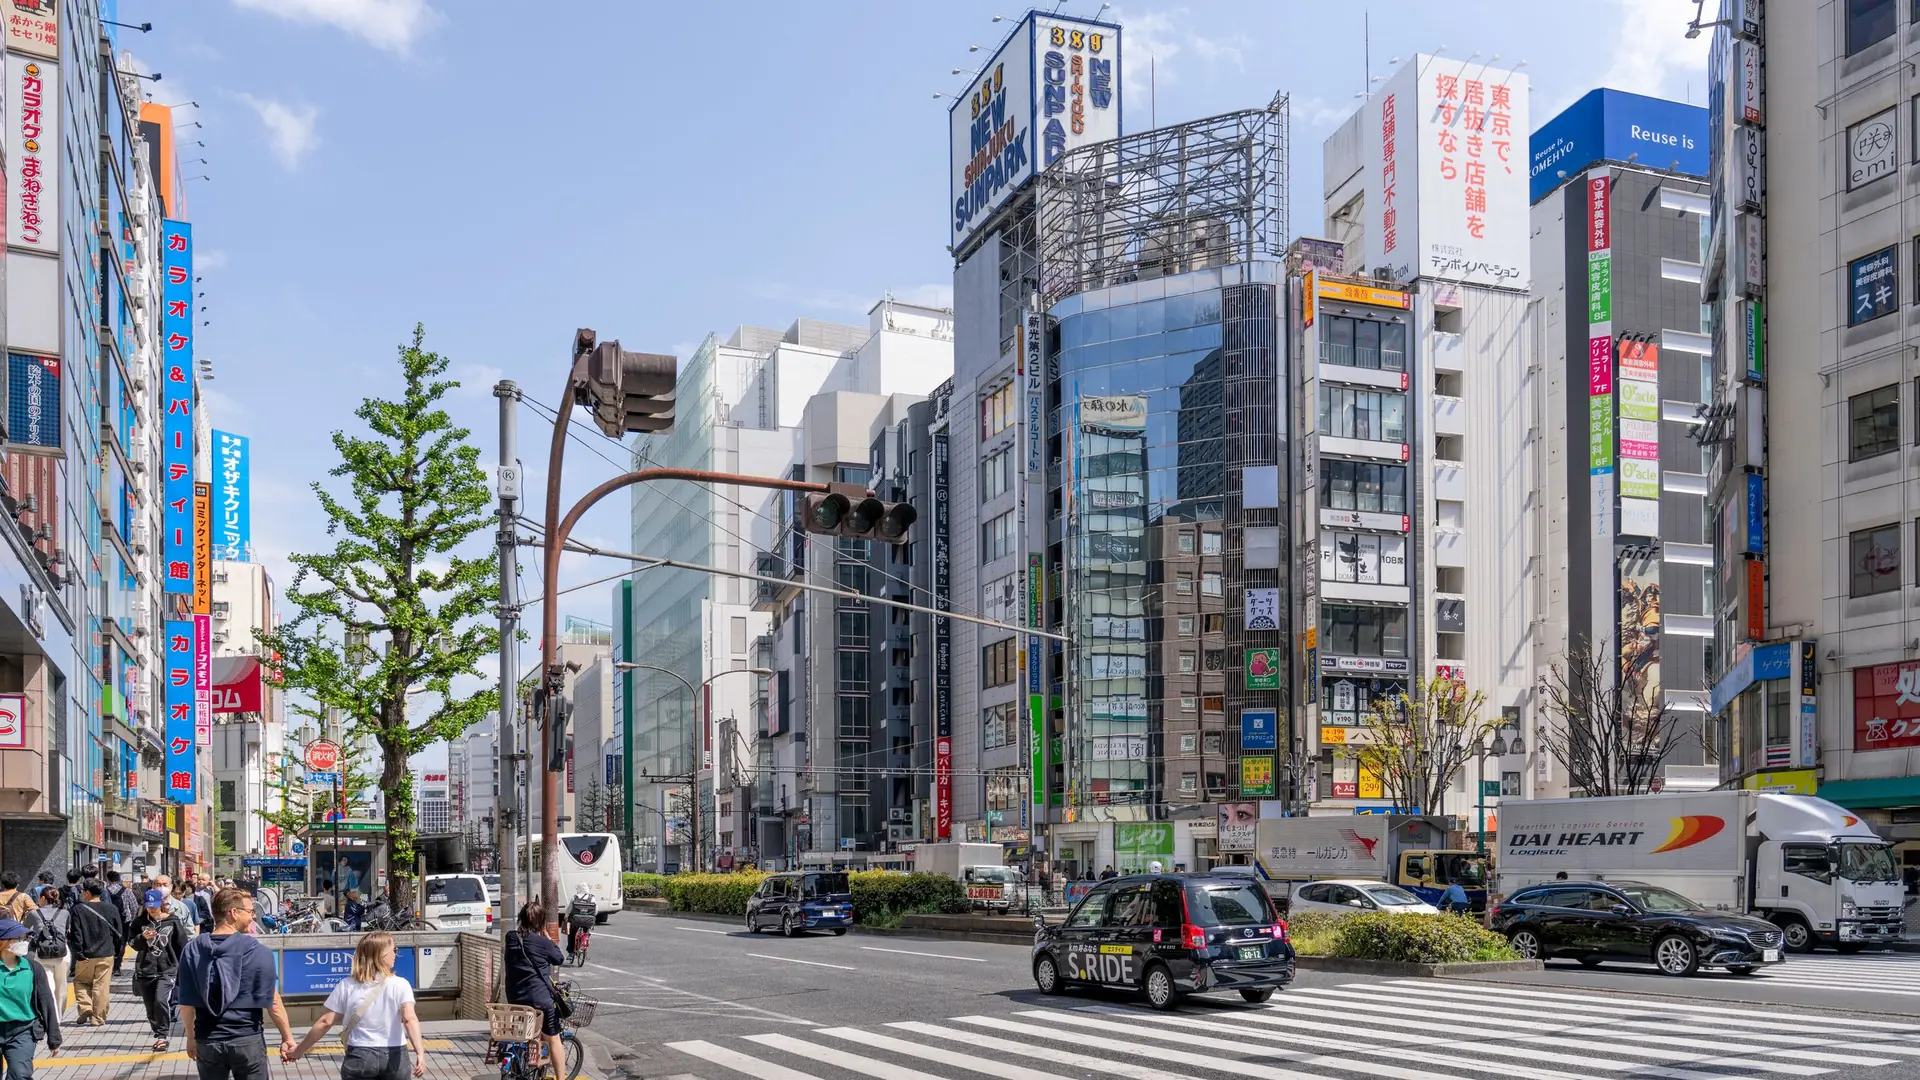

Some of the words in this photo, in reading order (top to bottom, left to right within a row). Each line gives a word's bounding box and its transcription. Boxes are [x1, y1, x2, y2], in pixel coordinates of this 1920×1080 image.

[9, 14, 56, 34] 赤から鍋
[10, 27, 57, 46] セセリ焼
[1745, 23, 1755, 34] 6F
[1050, 26, 1104, 53] 389
[1089, 57, 1112, 108] NEW
[1745, 47, 1754, 102] パムッカレ
[972, 62, 1004, 120] 389
[1071, 55, 1085, 134] SHINJUKU
[22, 75, 43, 139] カラオケ
[970, 87, 1007, 159] NEW
[1435, 73, 1458, 180] 探すなら
[1490, 84, 1512, 175] 東京で、
[1631, 125, 1678, 146] Reuse
[1682, 134, 1694, 149] is
[964, 115, 1015, 188] SHINJUKU
[1463, 79, 1486, 239] 居抜き店舗を
[1535, 143, 1556, 161] Reuse
[1556, 137, 1564, 147] is
[955, 126, 1028, 232] SUNPARK
[1382, 93, 1396, 255] 店舗専門不動産
[1747, 129, 1757, 201] MOUTON
[1852, 151, 1895, 183] emi
[20, 156, 43, 245] まねきねこ
[1594, 191, 1605, 249] 東京美容外科
[1431, 243, 1464, 256] 株式会社
[1431, 255, 1520, 279] テンポイノベーション
[1601, 261, 1610, 294] オラクル
[1855, 266, 1894, 288] 美容皮膚科
[1858, 256, 1889, 275] 美容外科
[1591, 262, 1601, 311] 美容皮膚科
[1856, 285, 1893, 314] スキ
[1594, 311, 1607, 320] 8F
[1592, 339, 1601, 383] クリニック
[1601, 338, 1609, 373] フィラー
[1402, 374, 1408, 388] 7F
[1594, 383, 1608, 393] 7F
[1622, 384, 1656, 403] Oracle
[167, 233, 190, 580] カラオケ&パーティー館
[1602, 396, 1612, 436] オラクル
[1030, 397, 1039, 458] パステルコート
[1591, 397, 1602, 456] 美容皮膚科
[1403, 444, 1408, 459] 6F
[1621, 442, 1658, 450] フィラークリニック
[1595, 457, 1608, 466] 6F
[1622, 461, 1657, 480] Oracle
[223, 457, 241, 559] オザキクリニック
[1403, 516, 1409, 530] 5F
[196, 501, 206, 606] コミック・インターネット
[1338, 573, 1355, 581] DOMA
[1250, 597, 1273, 606] ダーツ
[1250, 607, 1274, 615] グッズ
[1751, 628, 1760, 636] B2
[197, 654, 207, 687] コスモス
[1762, 658, 1791, 671] ゲウチ
[170, 634, 192, 790] カラオケ館
[312, 751, 336, 760] 消火栓
[938, 757, 950, 829] バーガーキング
[1119, 828, 1166, 846] レイク
[1509, 833, 1552, 846] DAI
[1557, 832, 1644, 846] HEART
[1509, 848, 1568, 856] Logistic
[305, 952, 354, 965] SUBN
[1068, 952, 1135, 983] S.RIDE
